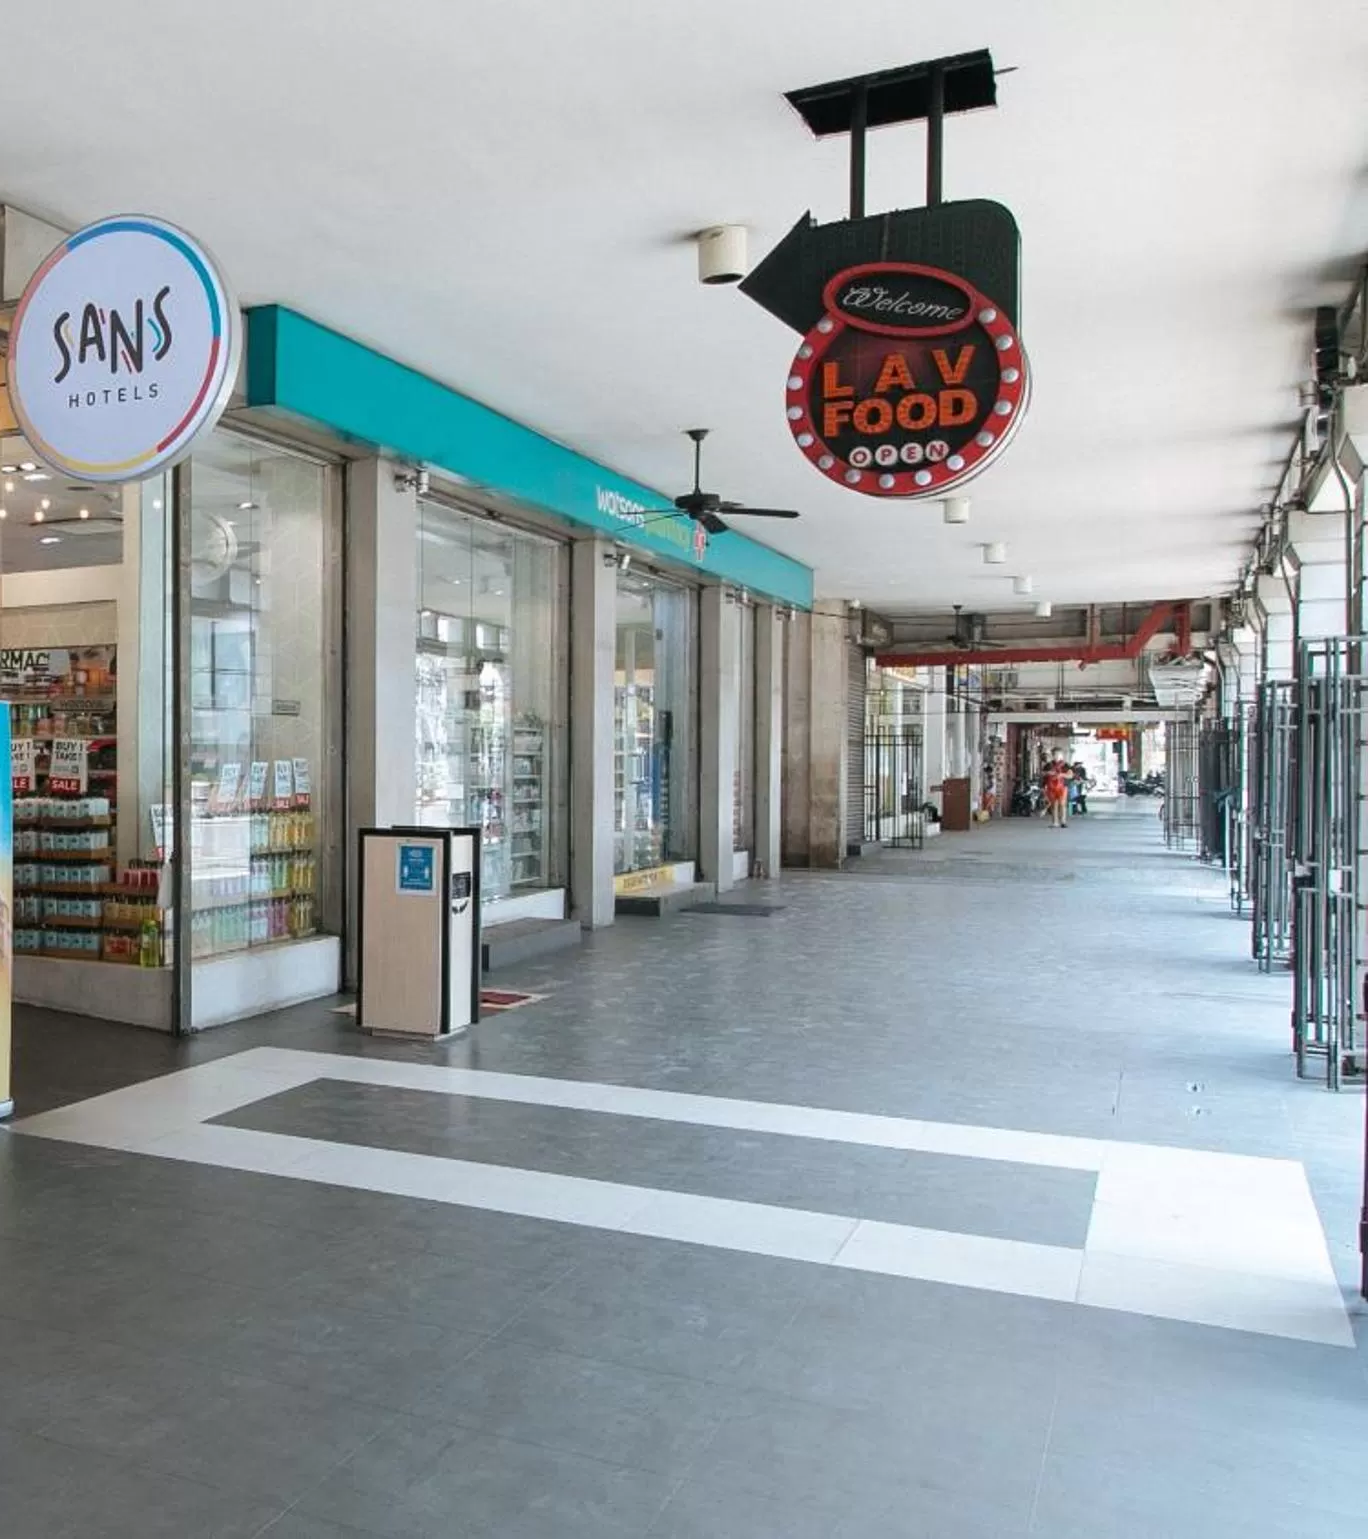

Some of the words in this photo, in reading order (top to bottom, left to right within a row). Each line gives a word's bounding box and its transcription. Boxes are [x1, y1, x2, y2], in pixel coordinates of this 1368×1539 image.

[841, 285, 965, 321] Welcome
[53, 286, 172, 384] SANS
[68, 383, 159, 409] HOTELS
[822, 388, 979, 438] FOOD
[850, 441, 948, 467] OPEN
[13, 777, 28, 789] LE
[51, 779, 78, 790] SALE
